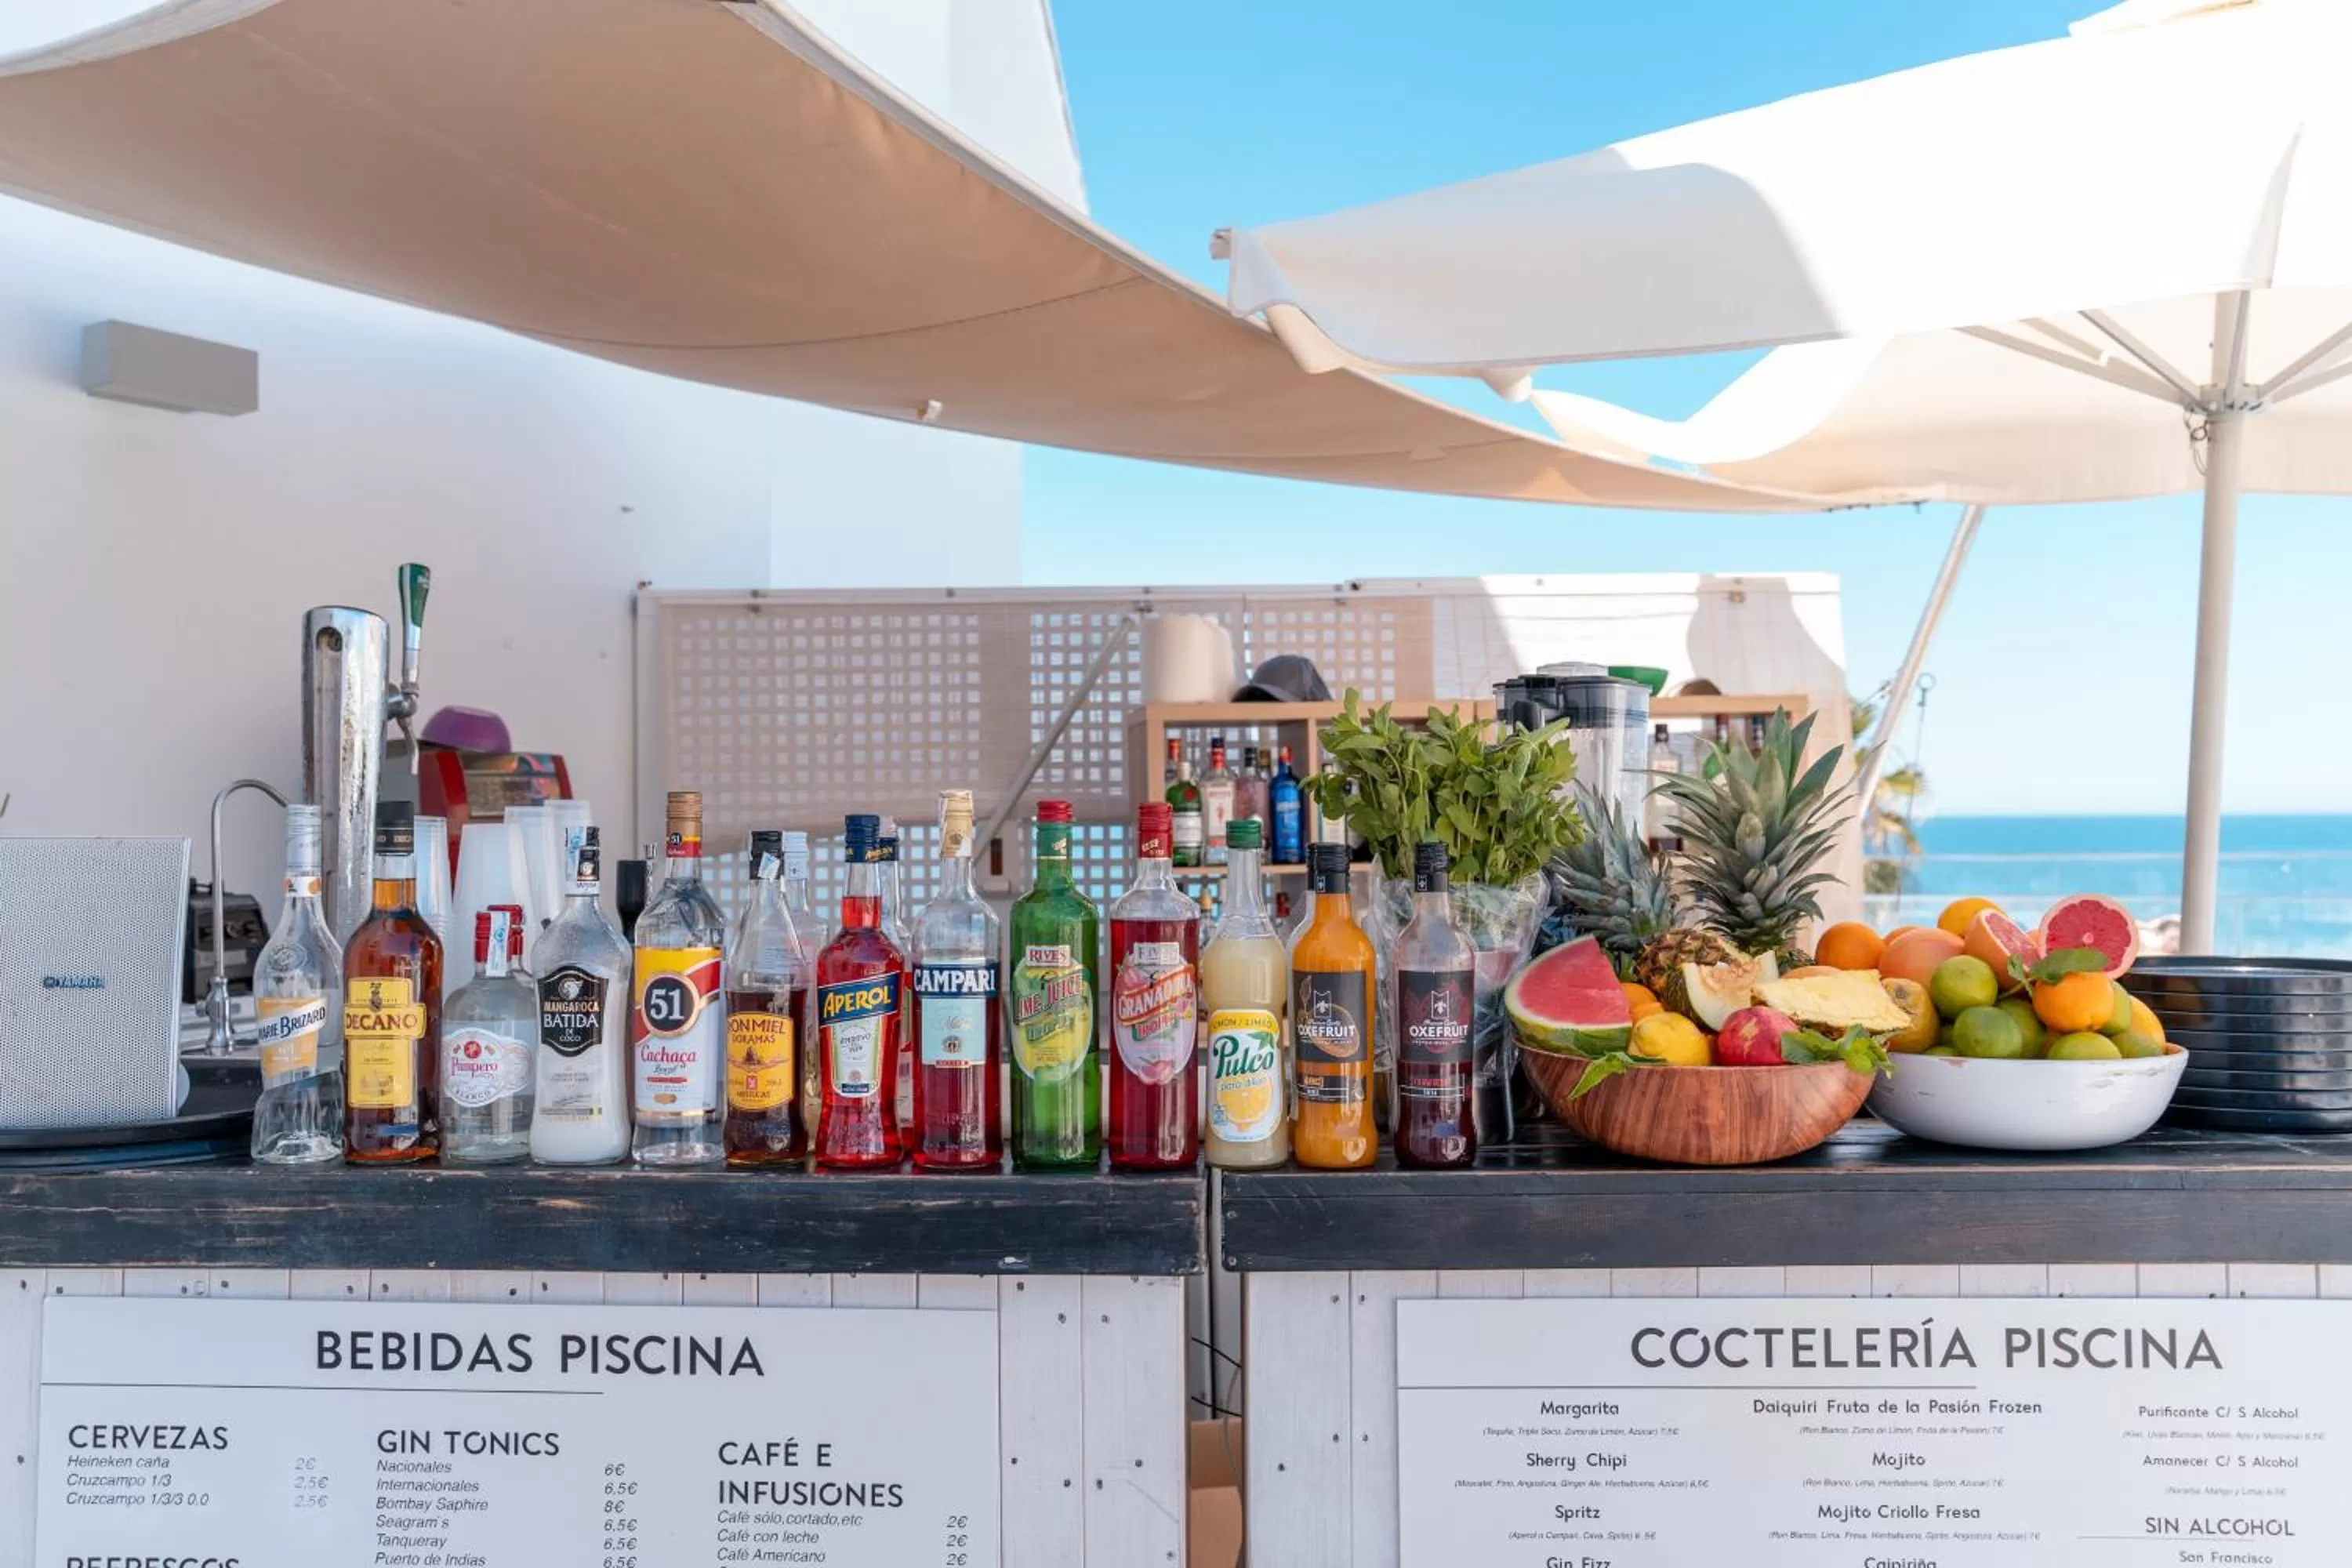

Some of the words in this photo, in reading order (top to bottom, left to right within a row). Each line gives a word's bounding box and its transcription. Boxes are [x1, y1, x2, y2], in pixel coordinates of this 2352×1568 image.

[1029, 949, 1067, 963] RIVES
[913, 969, 996, 993] CAMPARI
[544, 1001, 600, 1013] MANGAROCA
[649, 988, 684, 1021] 51
[824, 985, 891, 1018] APEROL
[279, 1006, 326, 1039] BRIZARD
[346, 1014, 418, 1031] DECANO
[544, 1014, 599, 1028] BATIDA
[752, 1019, 786, 1034] MIEL
[1298, 1025, 1356, 1037] OXEFRUIT
[1409, 1025, 1468, 1037] OXEFRUIT
[641, 1044, 698, 1069] Cachaça
[1213, 1035, 1274, 1080] Pulco
[452, 1056, 498, 1079] Pampero
[1631, 1317, 1977, 1369] COCTELERÍA
[2005, 1327, 2223, 1370] PISCINA
[317, 1330, 532, 1373] BEBIDAS
[561, 1334, 764, 1377] PISCINA
[1541, 1401, 1619, 1419] Margarita
[1753, 1399, 1817, 1417] Daiquiri
[1828, 1399, 1870, 1414] Fruta
[1878, 1399, 1898, 1414] de
[1906, 1399, 1919, 1414] la
[1929, 1399, 1980, 1414] Pasión
[1989, 1399, 2042, 1414] Frozen
[2139, 1406, 2209, 1417] Purificante
[2216, 1406, 2230, 1417] C/
[2239, 1406, 2246, 1417] S
[2252, 1407, 2298, 1418] Alcohol
[68, 1425, 228, 1450] CERVEZAS
[377, 1430, 430, 1454] GIN
[443, 1431, 560, 1456] TONICS
[718, 1436, 799, 1467] CAFÉ
[817, 1443, 832, 1468] E
[1872, 1452, 1926, 1470] Mojito
[67, 1455, 132, 1468] Heineken
[136, 1456, 170, 1468] caña
[294, 1457, 317, 1470] 2€
[376, 1459, 452, 1473] Nacionales
[604, 1463, 626, 1476] 6€
[1526, 1453, 1577, 1472] Sherry
[1586, 1453, 1627, 1471] Chipi
[2143, 1455, 2208, 1466] Amanecer
[2216, 1455, 2230, 1467] C/
[2238, 1456, 2245, 1467] S
[2252, 1456, 2298, 1468] Alcohol
[67, 1474, 147, 1487] Cruzcampo
[151, 1474, 171, 1486] 1/3
[376, 1478, 480, 1493] Internacionales
[67, 1493, 145, 1506] Cruzcampo
[151, 1493, 183, 1506] 1/3/3
[719, 1480, 903, 1508] INFUSIONES
[376, 1497, 431, 1512] Bombay
[435, 1498, 488, 1512] Saphire
[604, 1500, 626, 1513] 8€
[1555, 1504, 1600, 1523] Spritz
[1818, 1505, 1871, 1523] Mojito
[1878, 1504, 1929, 1518] Criollo
[1936, 1504, 1980, 1519] Fresa
[717, 1510, 749, 1524] Café
[946, 1515, 968, 1529] 2€
[2145, 1517, 2180, 1534] SIN
[2189, 1518, 2296, 1537] ALCOHOL
[376, 1534, 447, 1548] Tanqueray
[717, 1529, 749, 1543] Café
[753, 1532, 779, 1543] con
[782, 1530, 818, 1544] leche
[946, 1534, 968, 1548] 2€
[375, 1552, 420, 1566] Puerto
[424, 1553, 441, 1566] de
[445, 1553, 486, 1567] Indias
[717, 1548, 749, 1562] Café
[752, 1548, 826, 1563] Americano
[946, 1553, 968, 1566] 2€
[1546, 1557, 1573, 1568] Gin
[1581, 1557, 1611, 1568] Fizz
[2179, 1551, 2204, 1563] San
[2211, 1552, 2273, 1564] Francisco
